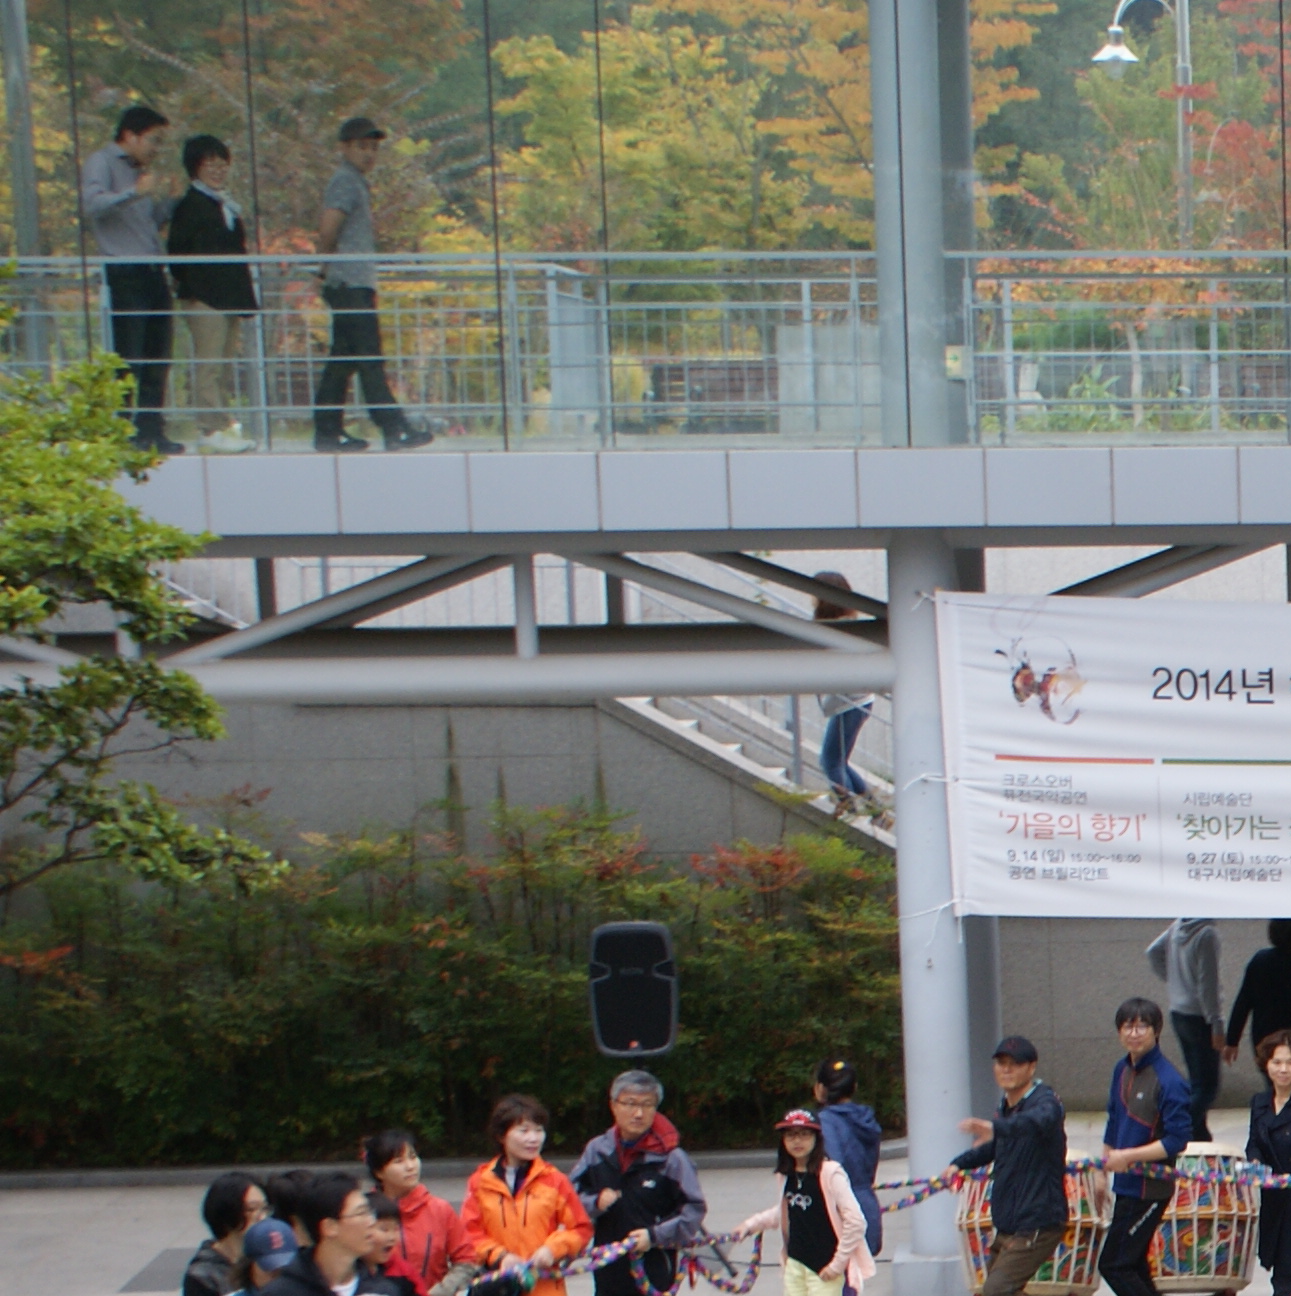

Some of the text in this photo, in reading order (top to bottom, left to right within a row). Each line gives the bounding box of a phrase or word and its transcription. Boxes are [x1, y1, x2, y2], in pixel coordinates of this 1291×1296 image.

[1152, 665, 1275, 706] 2014년
[1002, 773, 1073, 789] 크로스오버
[1183, 791, 1253, 807] 시립예술단
[1008, 866, 1036, 881] 공연
[1187, 867, 1283, 882] 대구시립예술단
